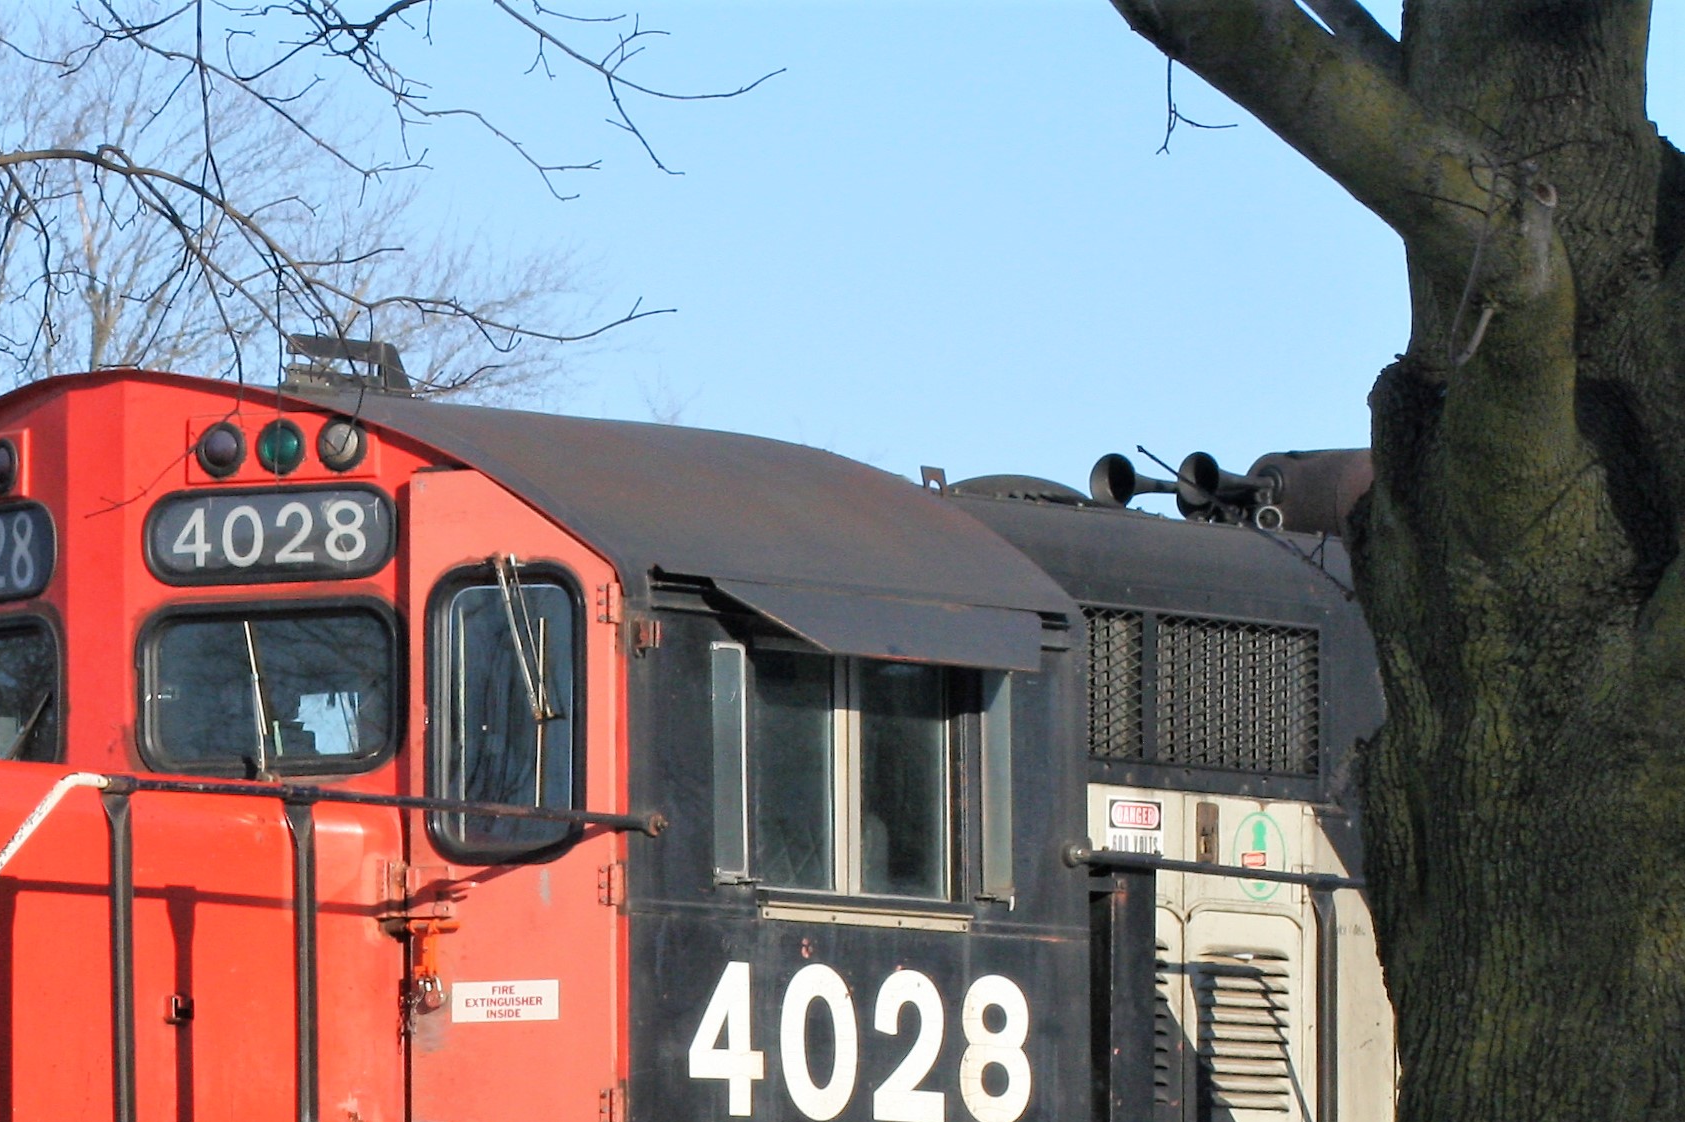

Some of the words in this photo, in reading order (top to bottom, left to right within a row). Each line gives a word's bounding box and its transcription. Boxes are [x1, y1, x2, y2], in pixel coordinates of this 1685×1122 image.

[173, 499, 366, 568] 4028
[1116, 805, 1156, 825] DANGER
[491, 985, 516, 995] FIRE
[464, 996, 544, 1008] EXTINGUISHER
[486, 1008, 522, 1019] INSIDE
